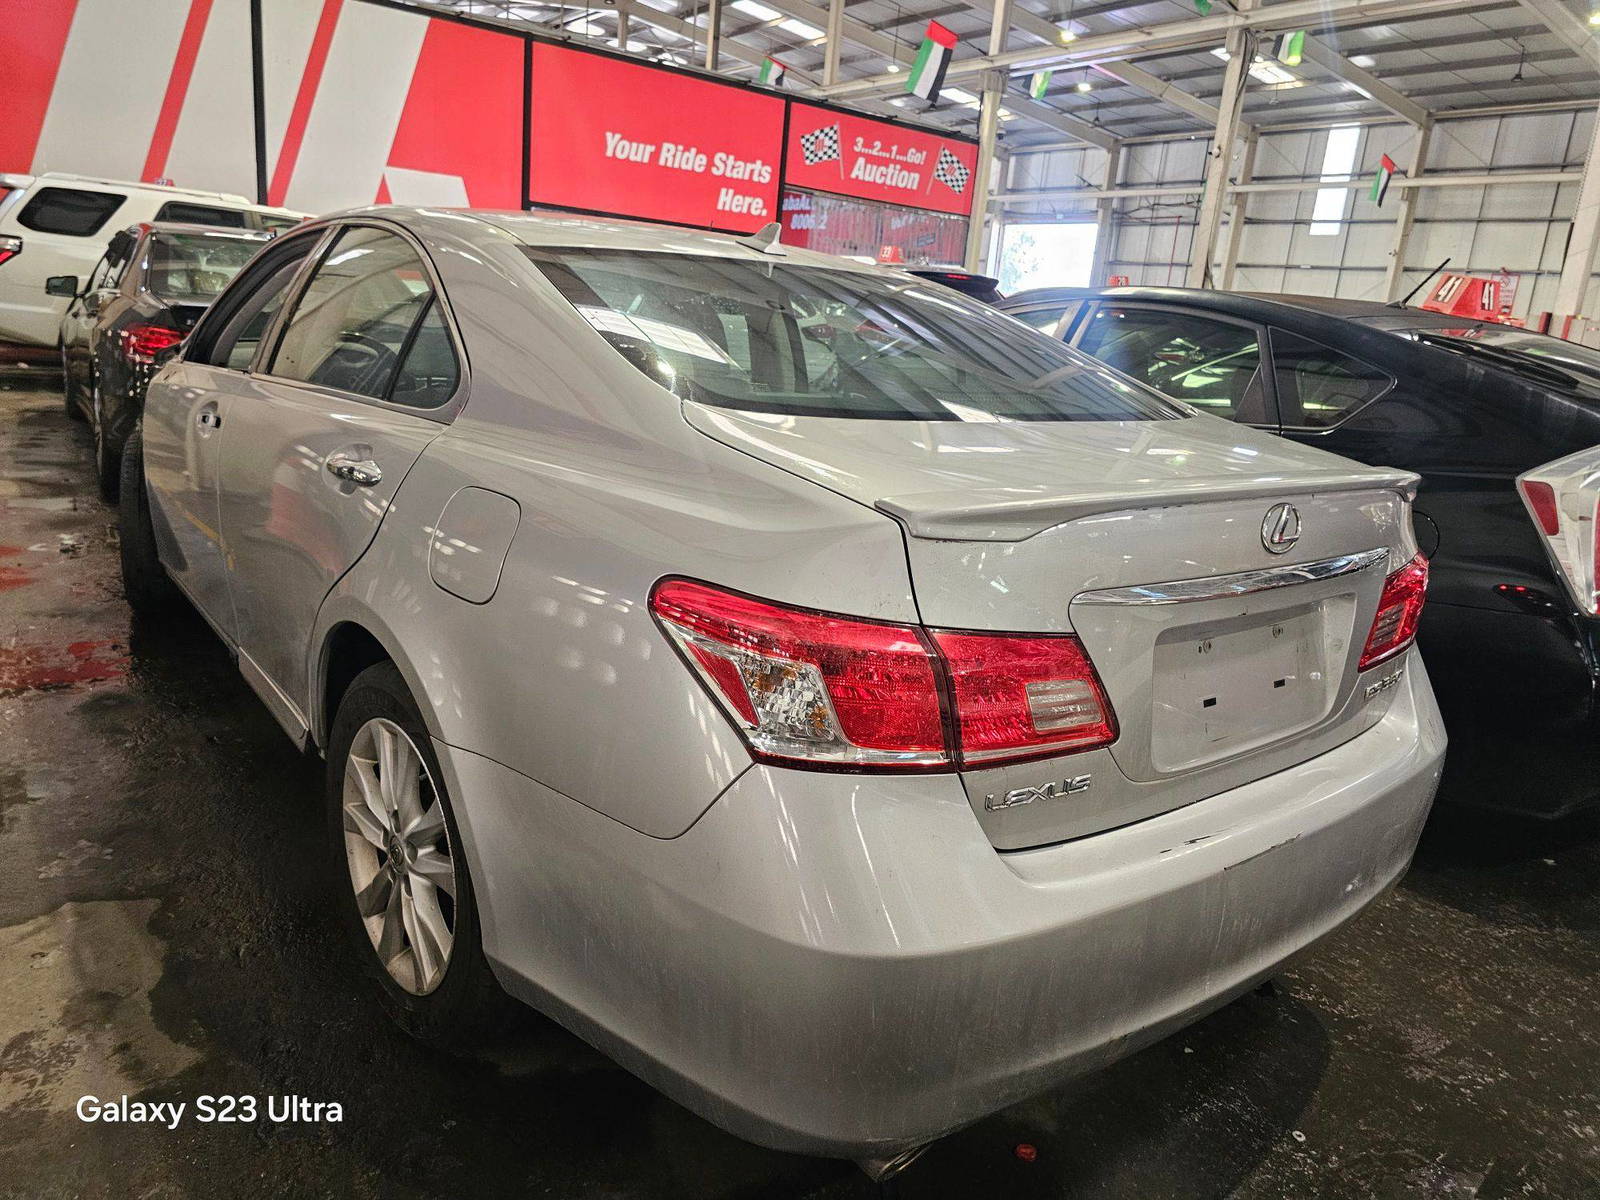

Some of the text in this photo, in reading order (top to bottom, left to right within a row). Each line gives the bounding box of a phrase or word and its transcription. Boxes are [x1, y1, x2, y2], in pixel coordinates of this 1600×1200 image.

[605, 131, 772, 184] Your Ride Starts
[850, 156, 921, 190] Auction
[716, 187, 768, 217] Here.
[1437, 275, 1463, 303] 41
[1481, 281, 1495, 311] 41
[984, 773, 1092, 813] LEXUS
